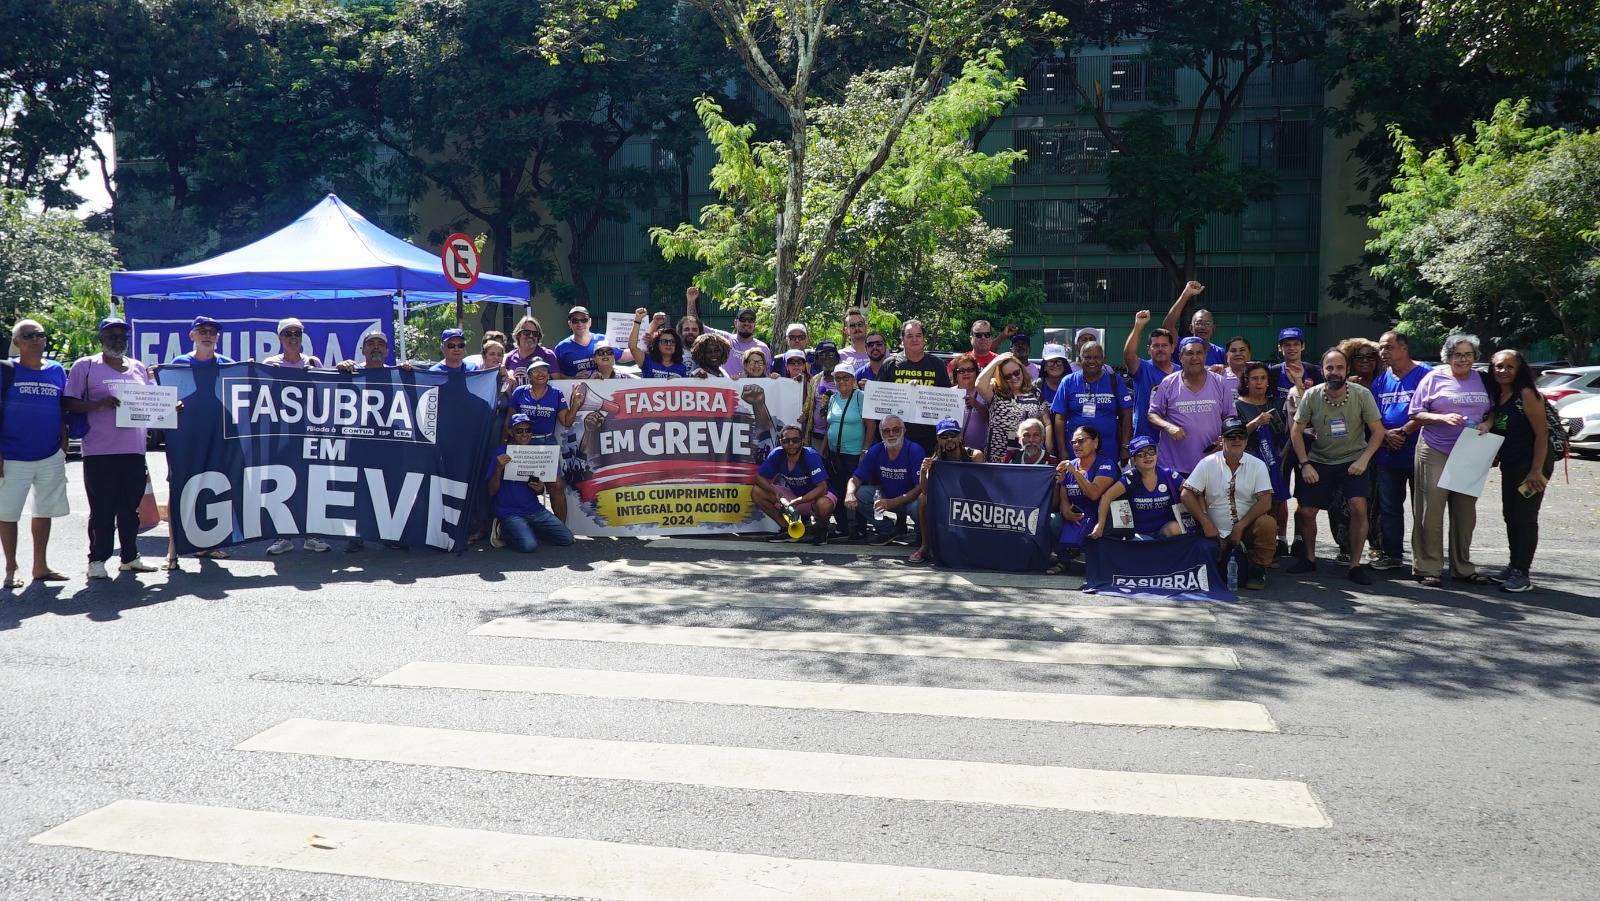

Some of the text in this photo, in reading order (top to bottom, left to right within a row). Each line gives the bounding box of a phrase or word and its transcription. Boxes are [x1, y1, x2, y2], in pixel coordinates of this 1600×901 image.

[232, 385, 412, 428] FASUBRA
[624, 391, 727, 413] FASUBRA
[1179, 405, 1197, 413] GREVE
[600, 421, 751, 455] EM GREVE
[303, 438, 346, 461] EM
[616, 488, 738, 502] PELO CUMPRIMENTO
[180, 464, 468, 552] GREVE
[617, 502, 740, 516] INTEGRAL DO ACORDO
[952, 501, 1026, 528] FASUBRA
[662, 515, 694, 526] 2024
[1116, 572, 1198, 589] FASUBRA
